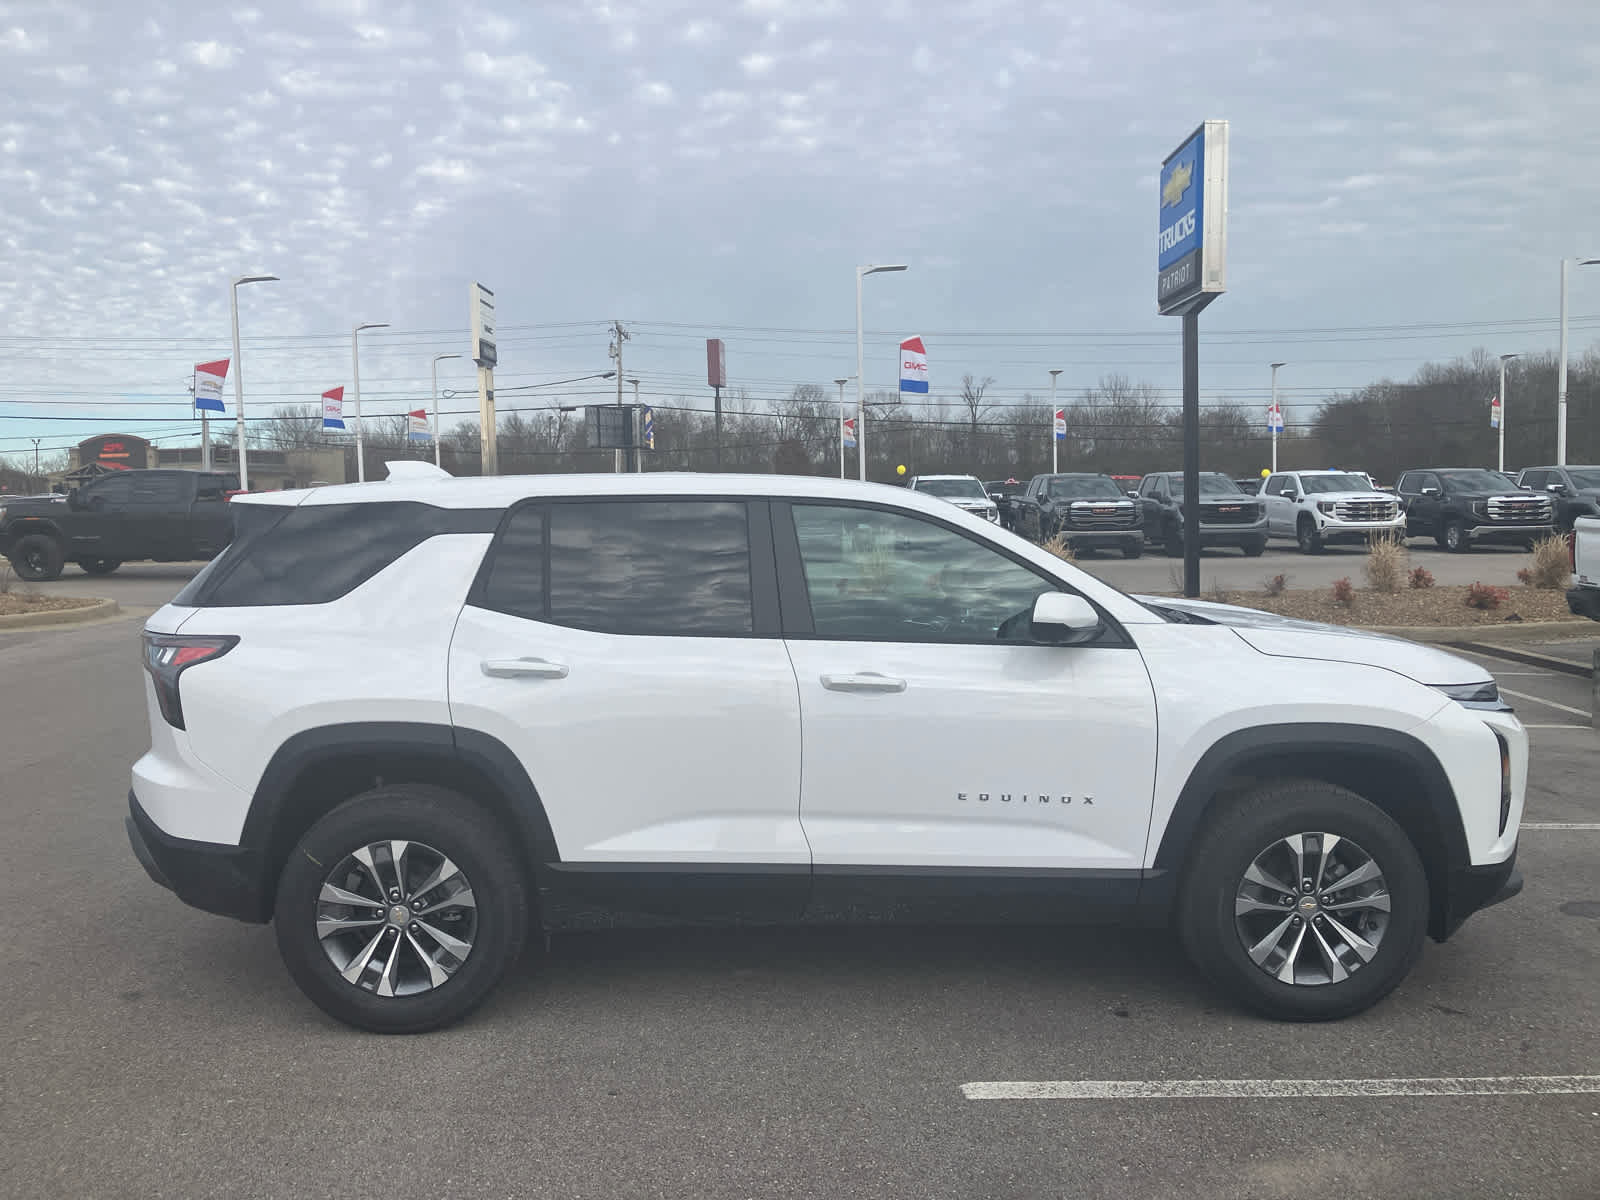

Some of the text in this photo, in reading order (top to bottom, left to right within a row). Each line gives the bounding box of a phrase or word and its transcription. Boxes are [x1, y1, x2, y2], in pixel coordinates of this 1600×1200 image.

[1159, 208, 1196, 254] TRUCKS
[1162, 263, 1191, 291] PATRIOT
[904, 361, 928, 371] GMC
[957, 792, 1094, 805] EQUINOX
